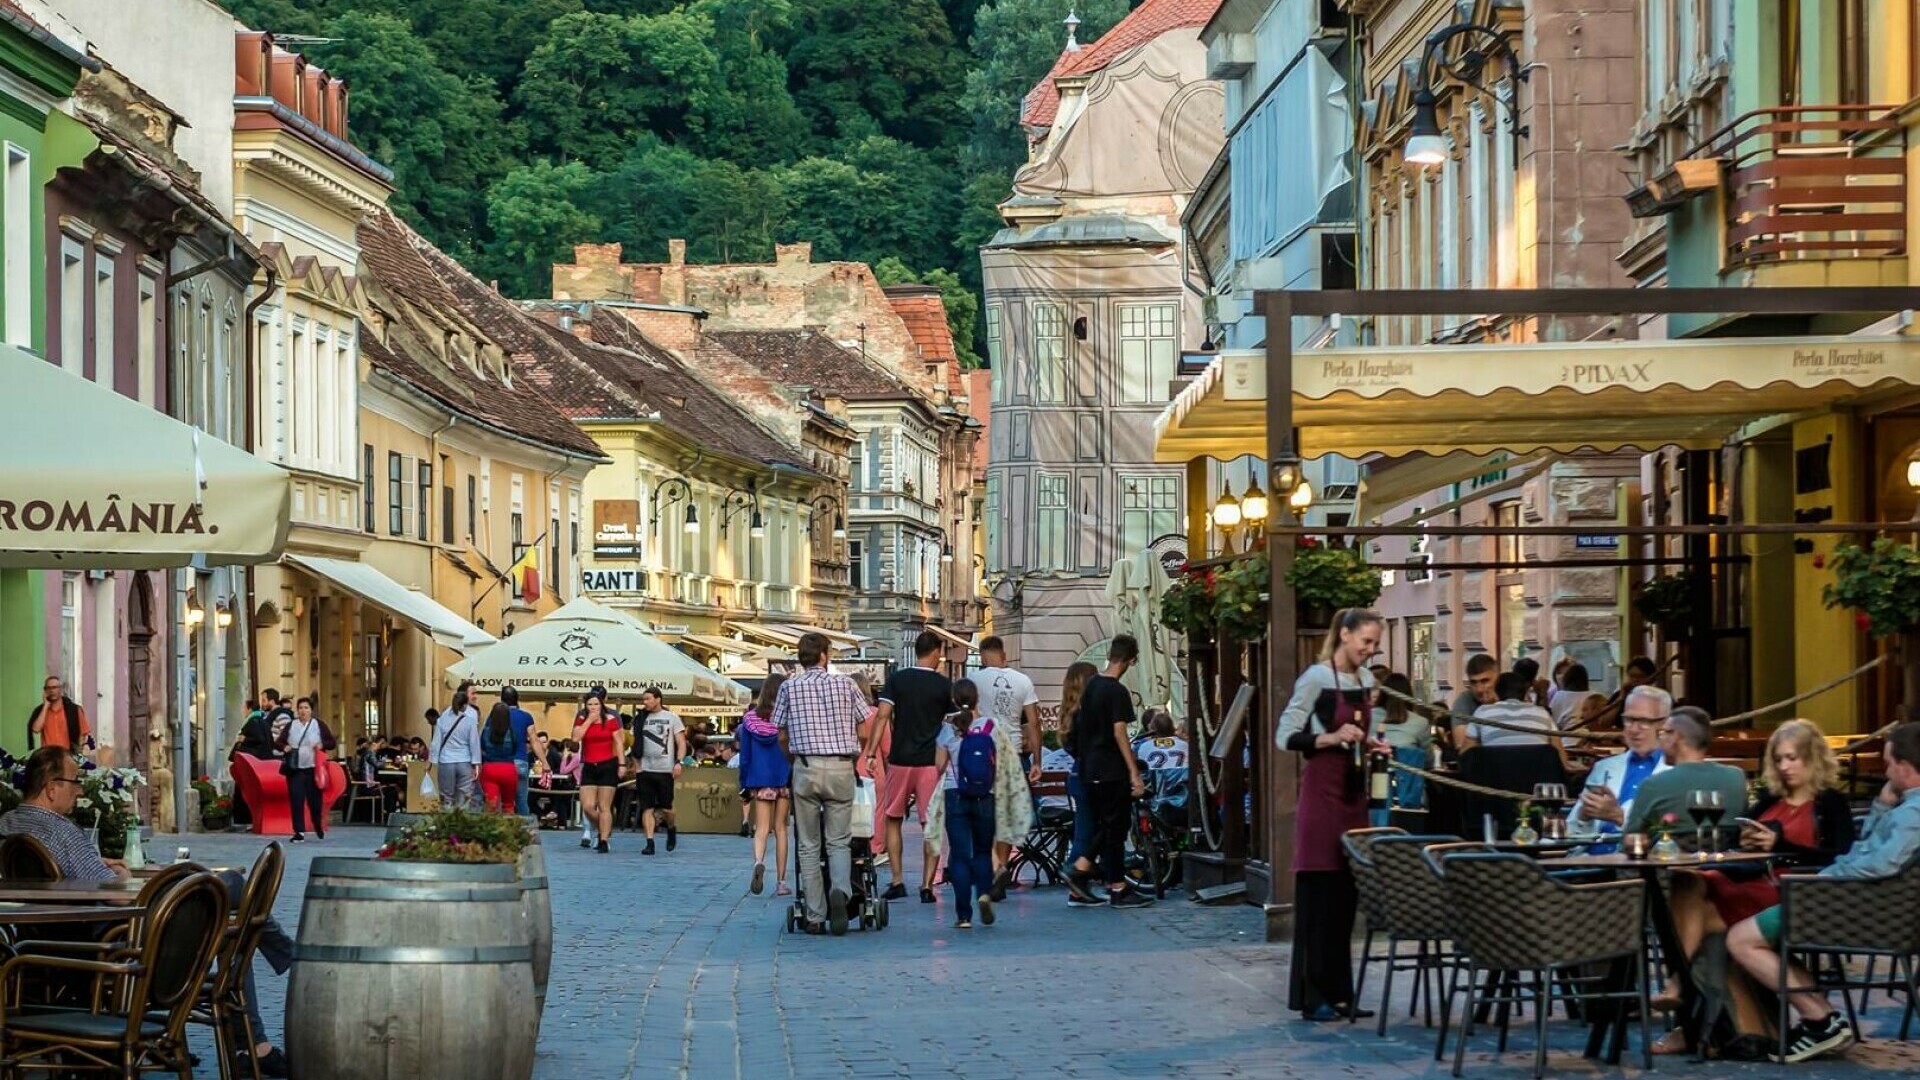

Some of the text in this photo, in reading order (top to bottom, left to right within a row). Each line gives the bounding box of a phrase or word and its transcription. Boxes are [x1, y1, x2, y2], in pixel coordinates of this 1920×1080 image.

[1793, 349, 1824, 367] Perla
[1322, 360, 1354, 378] Perla
[1574, 359, 1654, 384] PILVAX
[583, 571, 634, 590] RANT
[518, 655, 627, 668] BRAȘOV
[509, 678, 546, 687] REGELE
[607, 678, 619, 688] ÎN
[1147, 750, 1185, 768] 27
